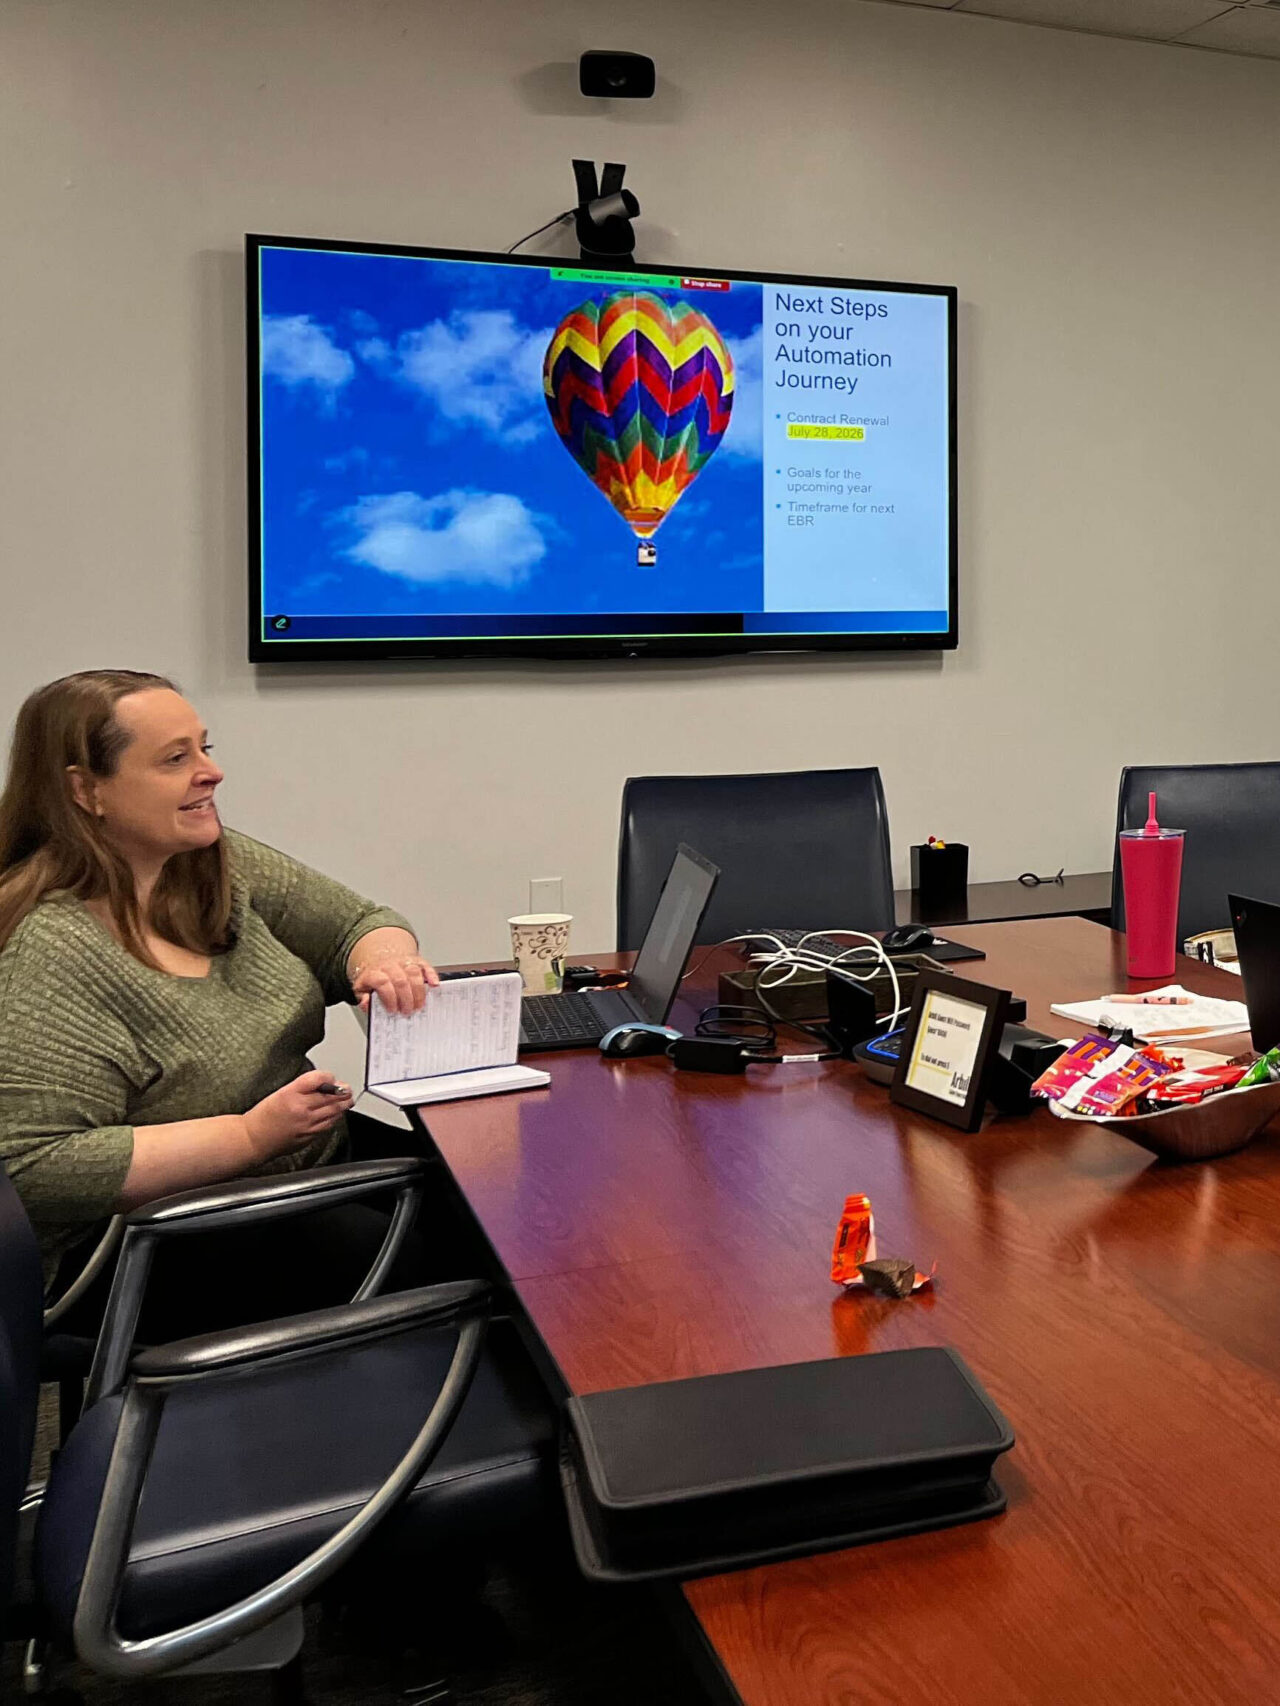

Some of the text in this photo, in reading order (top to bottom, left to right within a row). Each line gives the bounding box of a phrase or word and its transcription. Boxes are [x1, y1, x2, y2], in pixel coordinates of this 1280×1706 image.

[775, 292, 889, 321] Next Steps
[775, 321, 854, 343] on your
[774, 343, 893, 368] Automation
[775, 370, 859, 395] Journey
[786, 412, 890, 426] Contract Renewal
[787, 426, 865, 440] July 28, 2026
[787, 467, 862, 480] Goals for the
[787, 482, 872, 495] upcoming year
[787, 501, 896, 515] Timeframe for next
[787, 515, 815, 527] EBR
